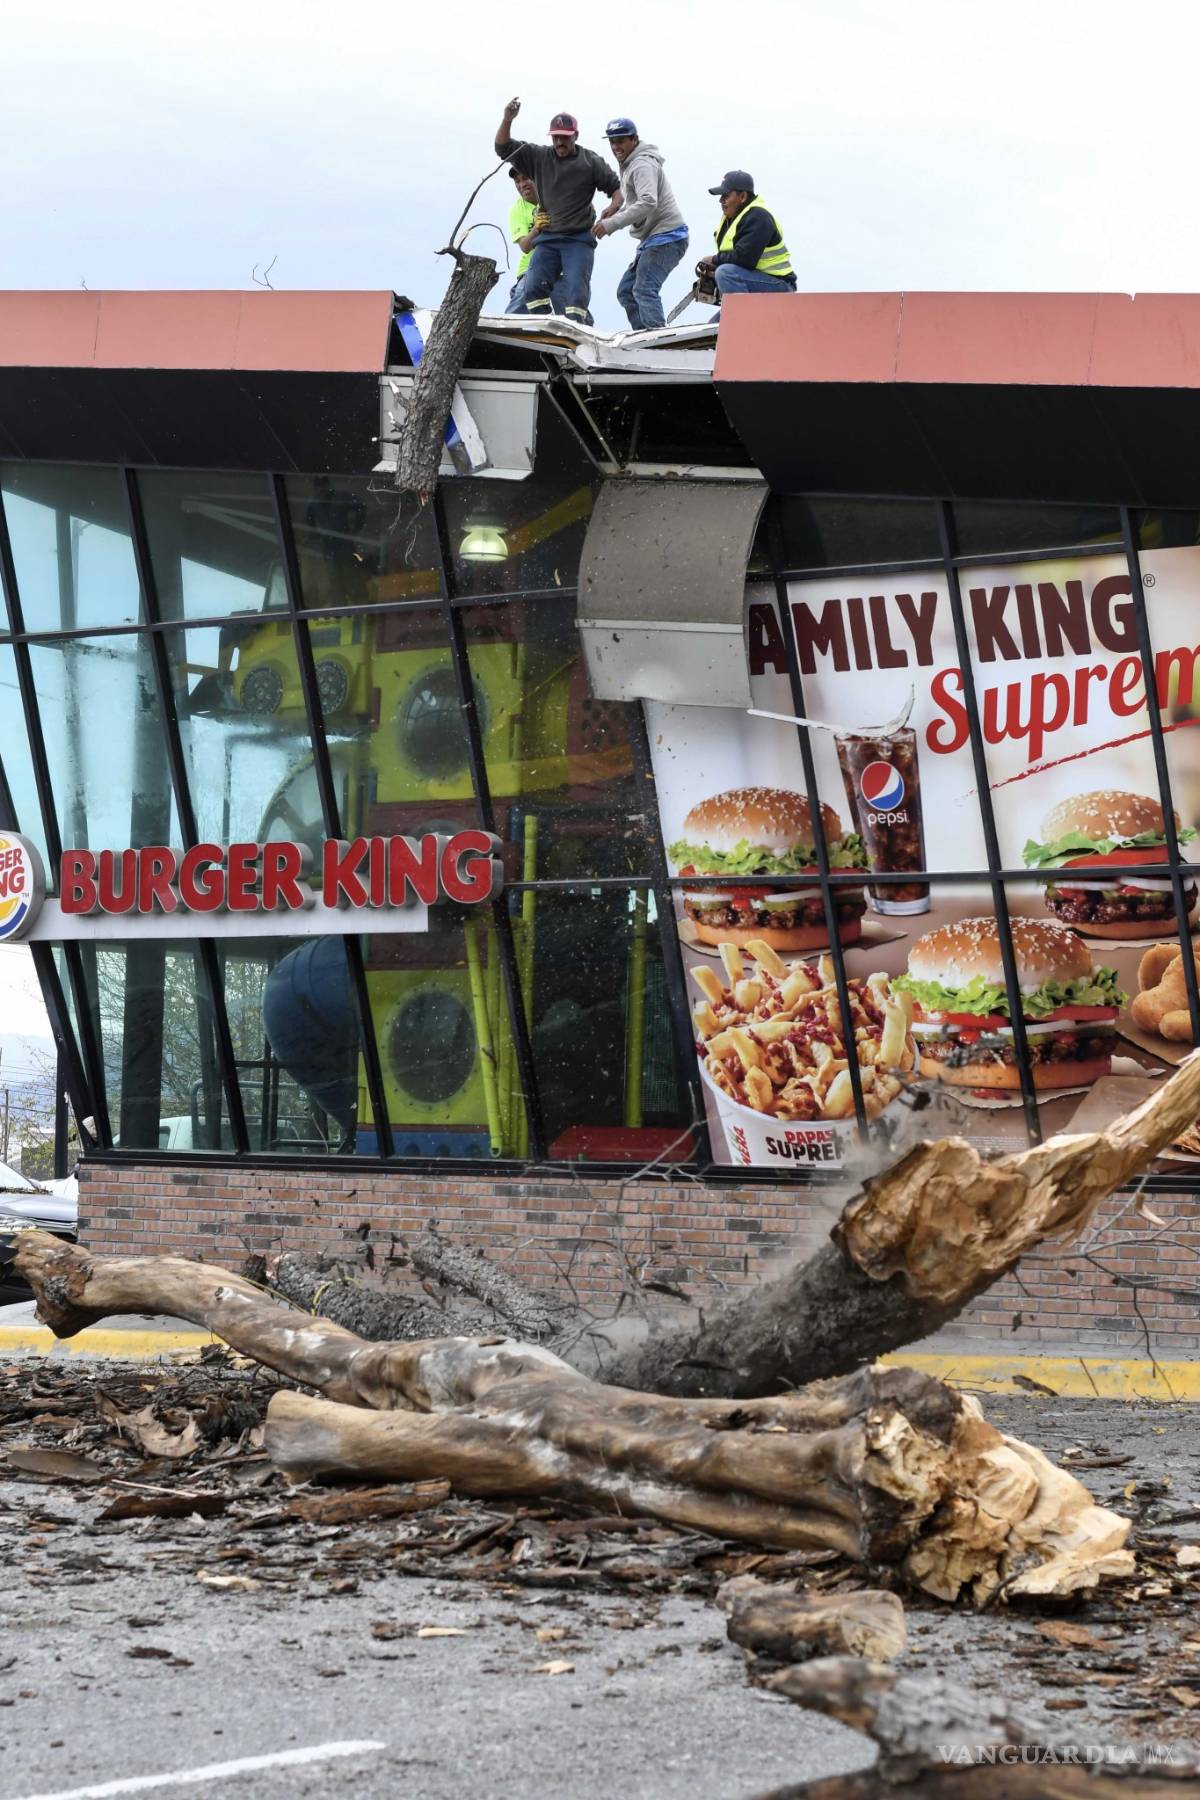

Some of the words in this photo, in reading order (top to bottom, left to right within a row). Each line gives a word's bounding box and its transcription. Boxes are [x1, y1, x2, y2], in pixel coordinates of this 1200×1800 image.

[969, 574, 1142, 663] KING
[867, 809, 908, 828] pepsi
[60, 841, 307, 915] BURGER
[322, 829, 498, 909] KING
